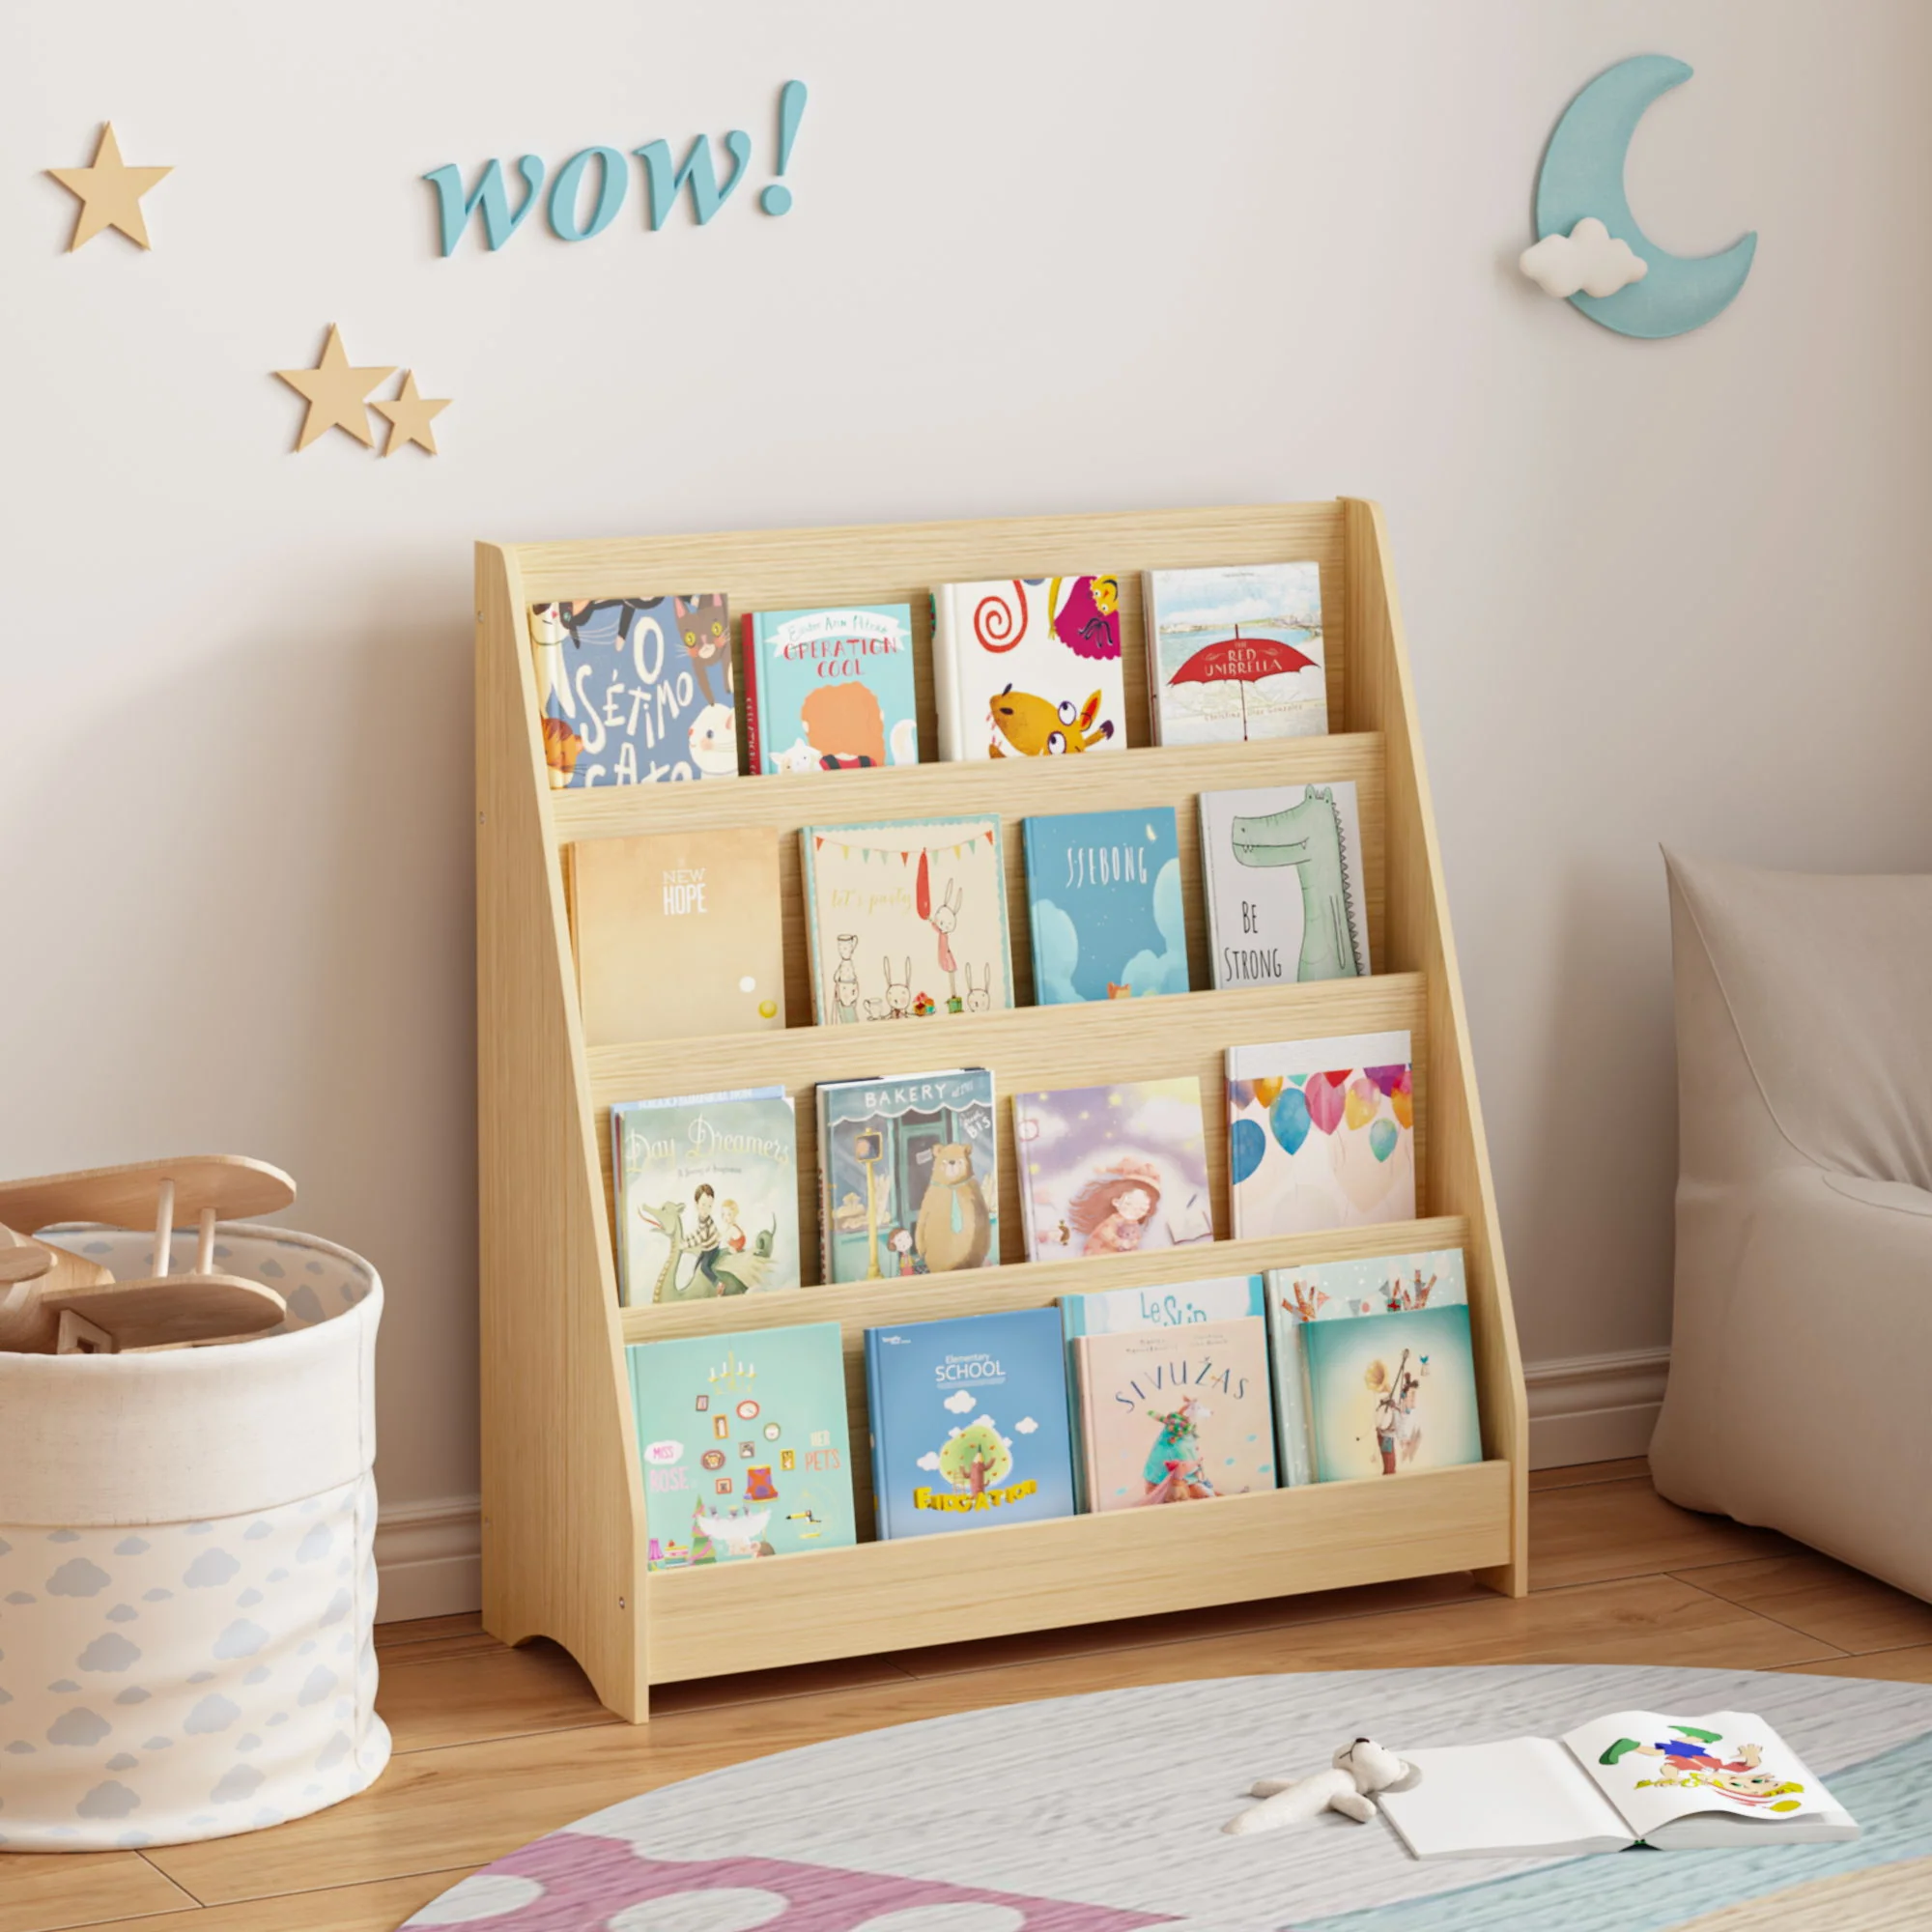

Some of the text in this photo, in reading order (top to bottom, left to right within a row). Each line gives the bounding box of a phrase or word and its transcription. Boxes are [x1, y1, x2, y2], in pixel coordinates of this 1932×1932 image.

[633, 616, 665, 685] O
[783, 638, 897, 661] OPERATION
[1228, 648, 1257, 662] RED
[817, 659, 866, 678] COOL
[1204, 659, 1283, 676] UMBRELLA
[663, 867, 706, 884] NEW
[663, 883, 708, 916] HOPE
[1241, 900, 1258, 934] BE
[1224, 947, 1283, 982] STRONG
[864, 1083, 947, 1108] BAKERY
[625, 1113, 790, 1173] Day Dreamers
[934, 1359, 1007, 1382] SCHOOL
[805, 1448, 841, 1472] PETS
[649, 1465, 692, 1492] ROSE
